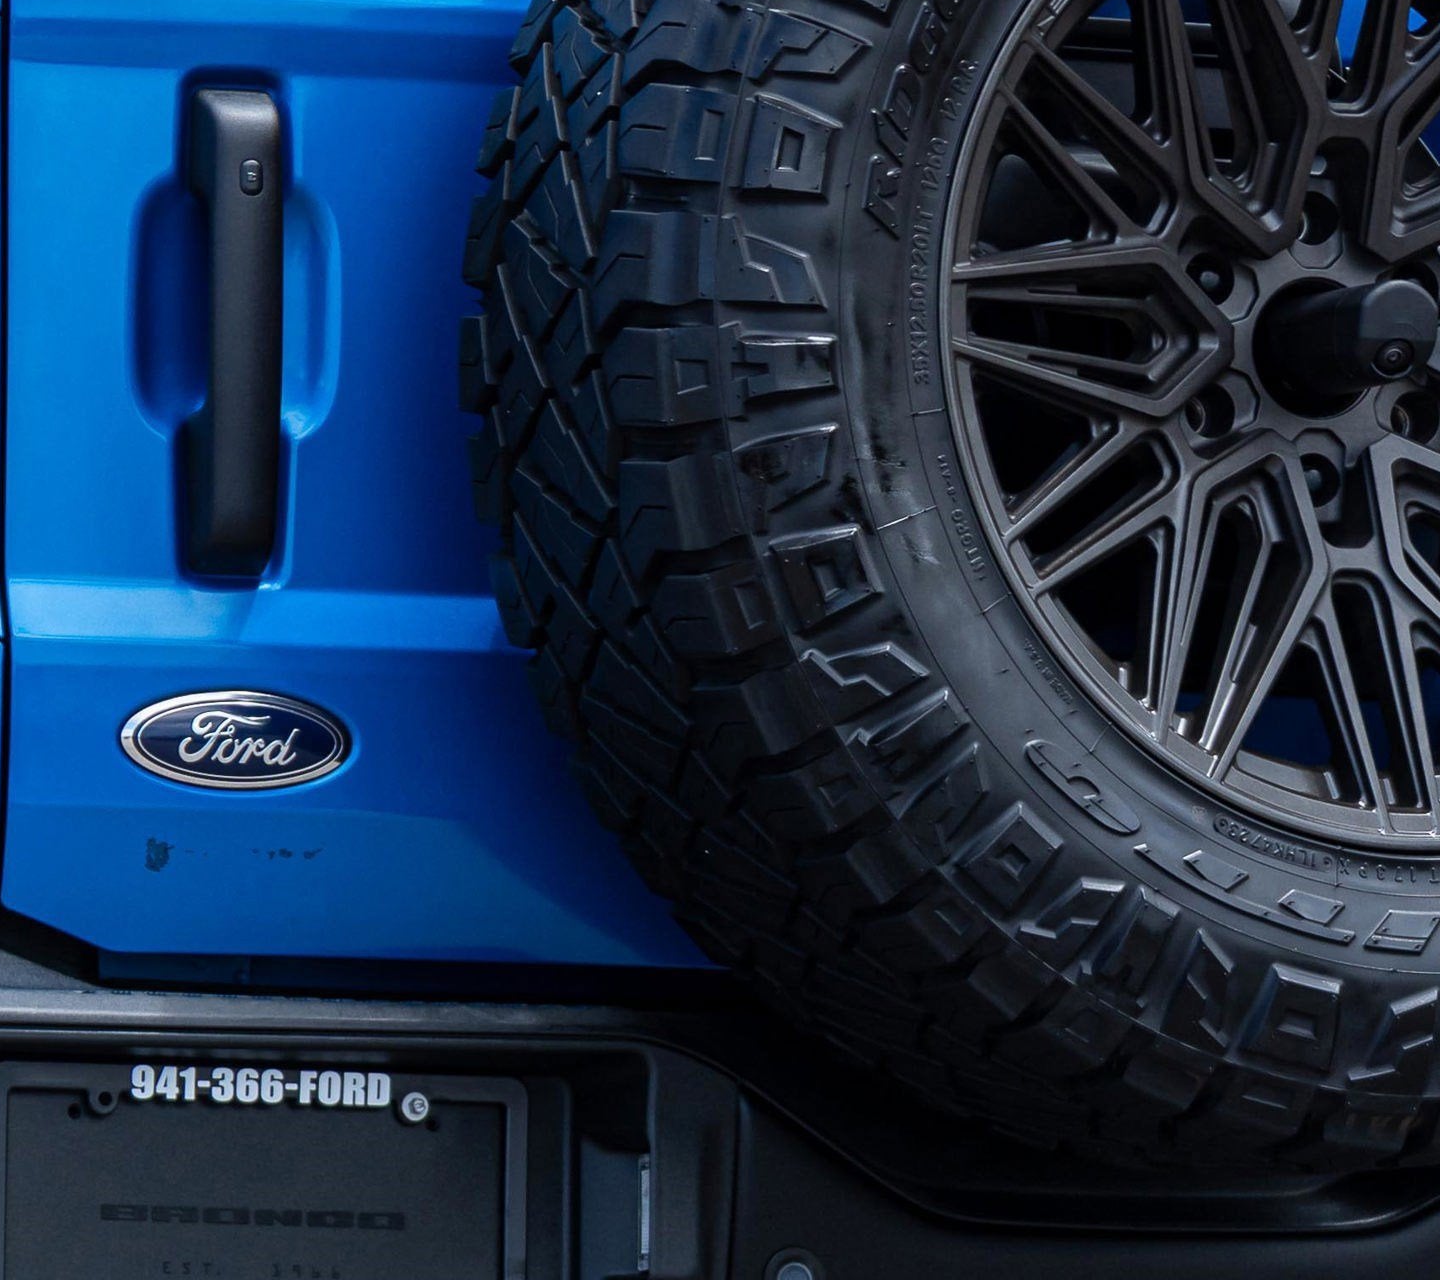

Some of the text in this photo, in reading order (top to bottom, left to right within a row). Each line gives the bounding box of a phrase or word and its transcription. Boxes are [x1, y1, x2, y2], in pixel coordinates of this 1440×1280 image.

[178, 710, 301, 766] Ford
[130, 1063, 391, 1108] 941-366-FORD
[100, 1203, 407, 1231] BRONCO
